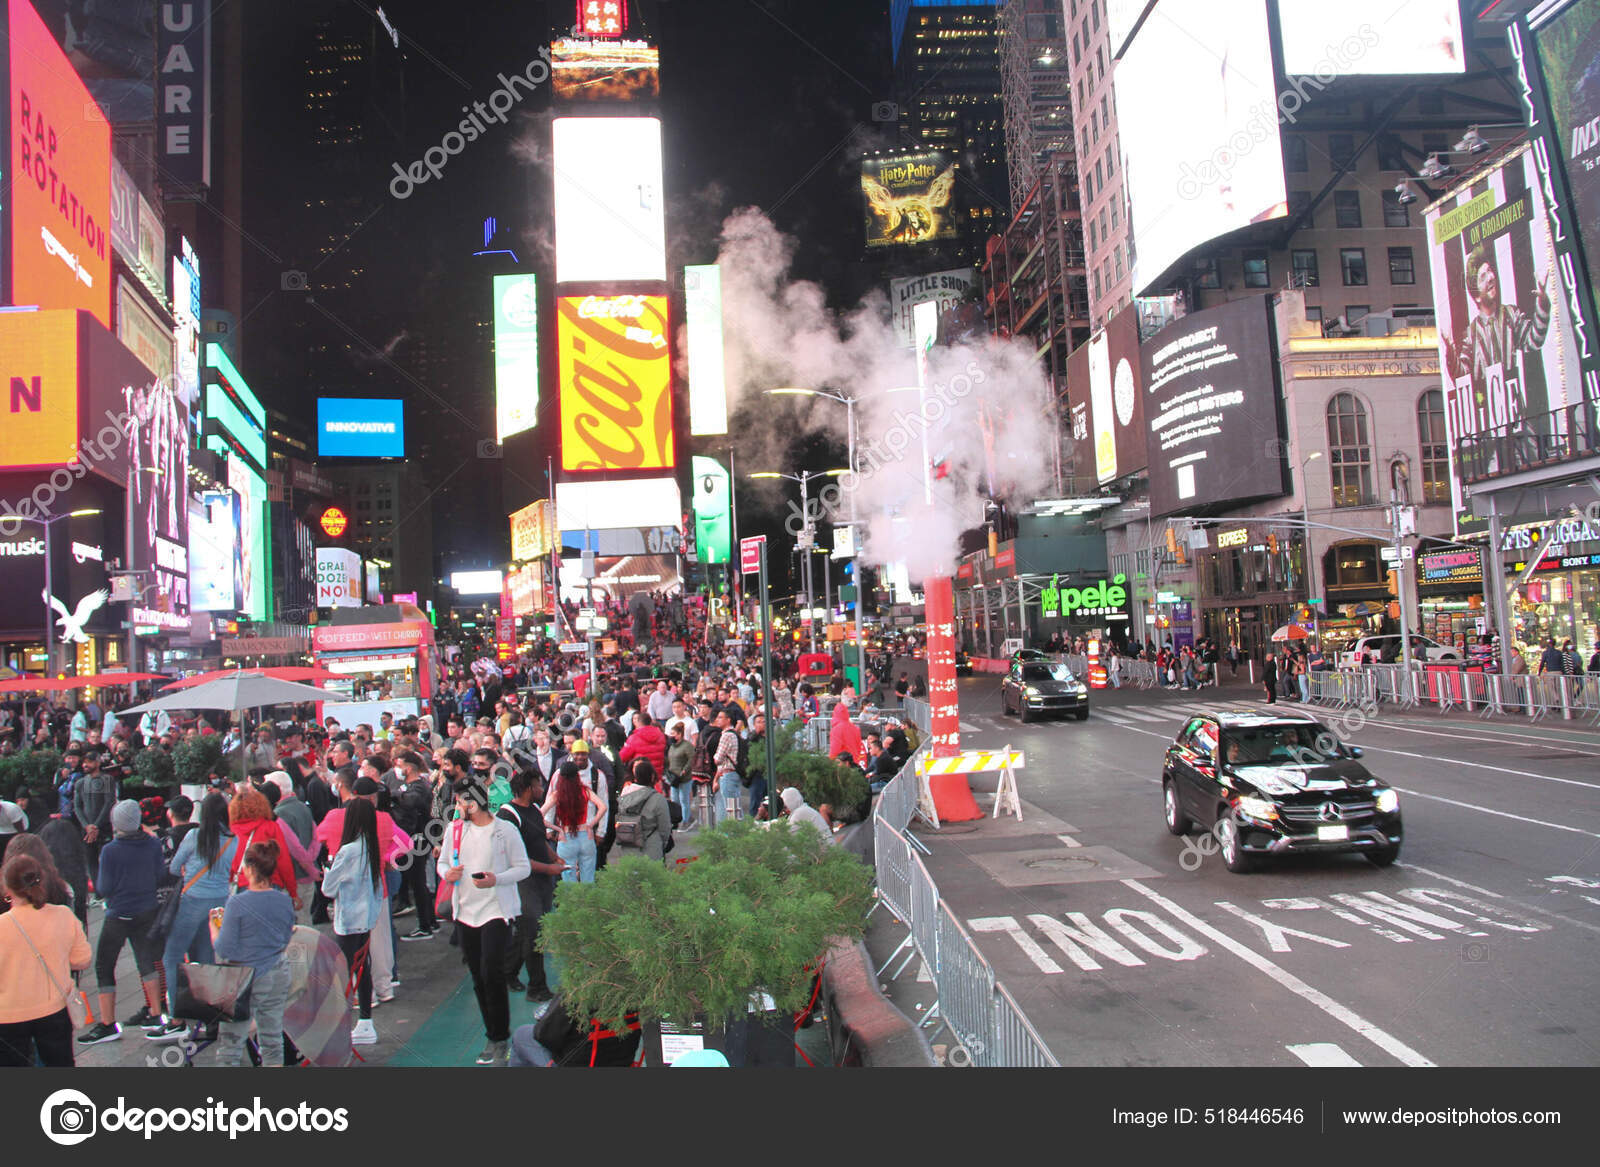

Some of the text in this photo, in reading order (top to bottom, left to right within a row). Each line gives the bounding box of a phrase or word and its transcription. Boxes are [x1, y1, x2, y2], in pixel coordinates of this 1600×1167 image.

[20, 88, 57, 160] RAP
[880, 166, 906, 185] Harry
[906, 163, 936, 181] Potter
[20, 134, 105, 262] ROTATION
[1438, 195, 1490, 239] RAISING SPIRITS
[1470, 199, 1525, 245] ON BROADWAY!
[901, 277, 938, 300] LITTLE
[1312, 364, 1336, 377] THE
[1340, 363, 1377, 376] SHOW
[1383, 361, 1422, 374] FOLKS
[10, 376, 41, 412] N
[325, 421, 396, 433] INNOVATIVE
[0, 537, 45, 556] music
[1217, 528, 1248, 548] EXPRESS
[1424, 552, 1477, 568] ELECTRONICS
[1563, 557, 1588, 567] SONY
[1061, 573, 1127, 617] pelé
[317, 633, 366, 643] COFFEED
[393, 630, 423, 640] CHURROS
